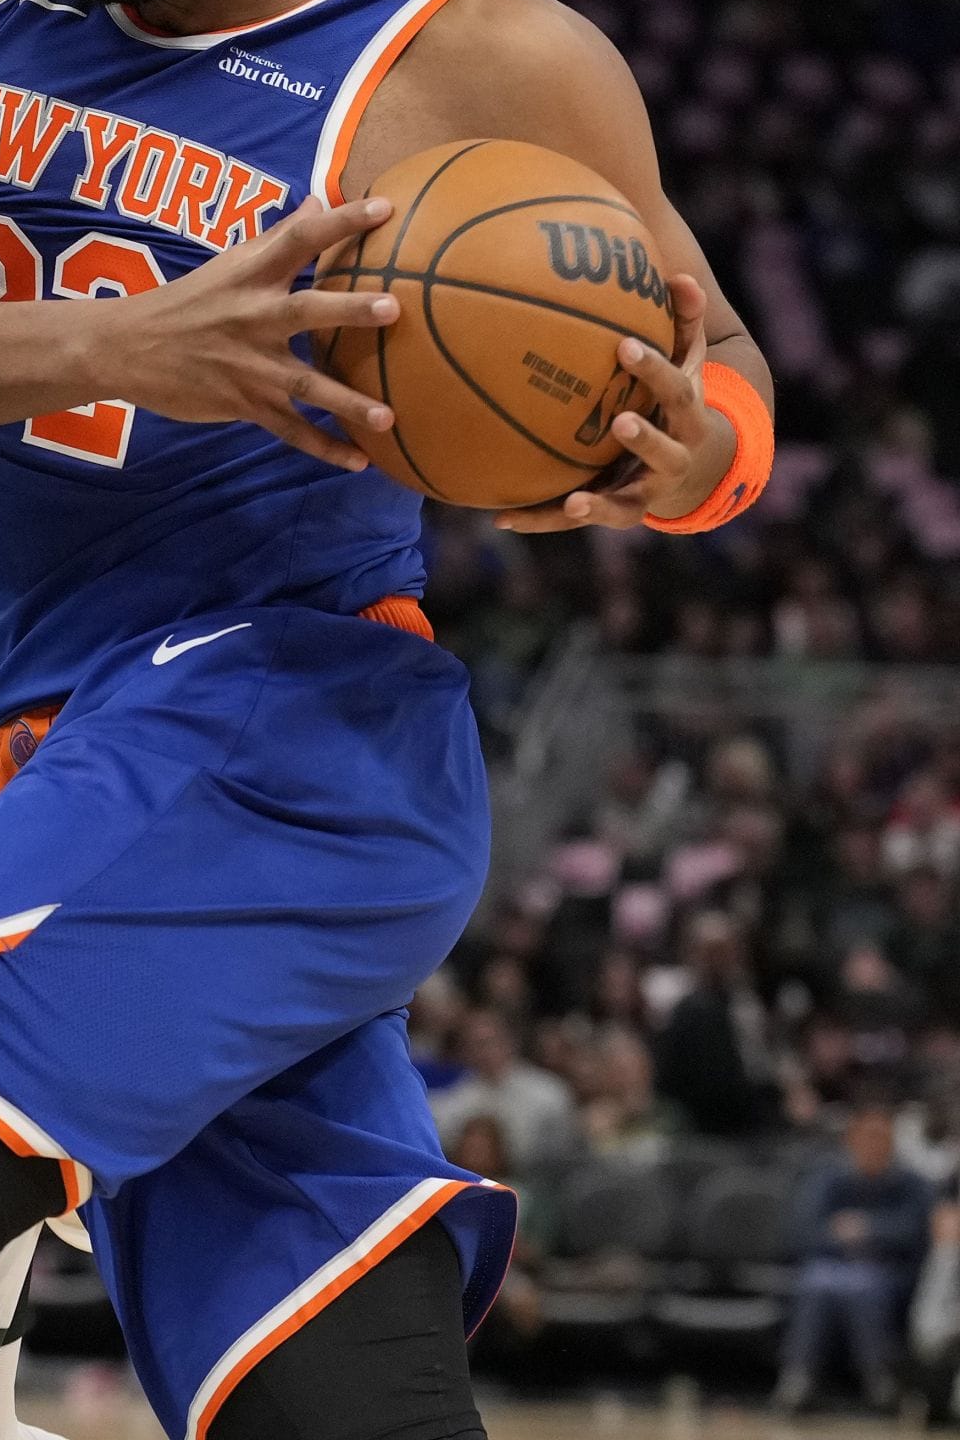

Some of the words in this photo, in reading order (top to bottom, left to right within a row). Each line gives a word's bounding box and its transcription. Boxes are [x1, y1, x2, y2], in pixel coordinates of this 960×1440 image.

[218, 57, 260, 81] abu
[261, 71, 326, 101] dhabi
[230, 46, 283, 70] experience
[70, 106, 291, 254] YORK
